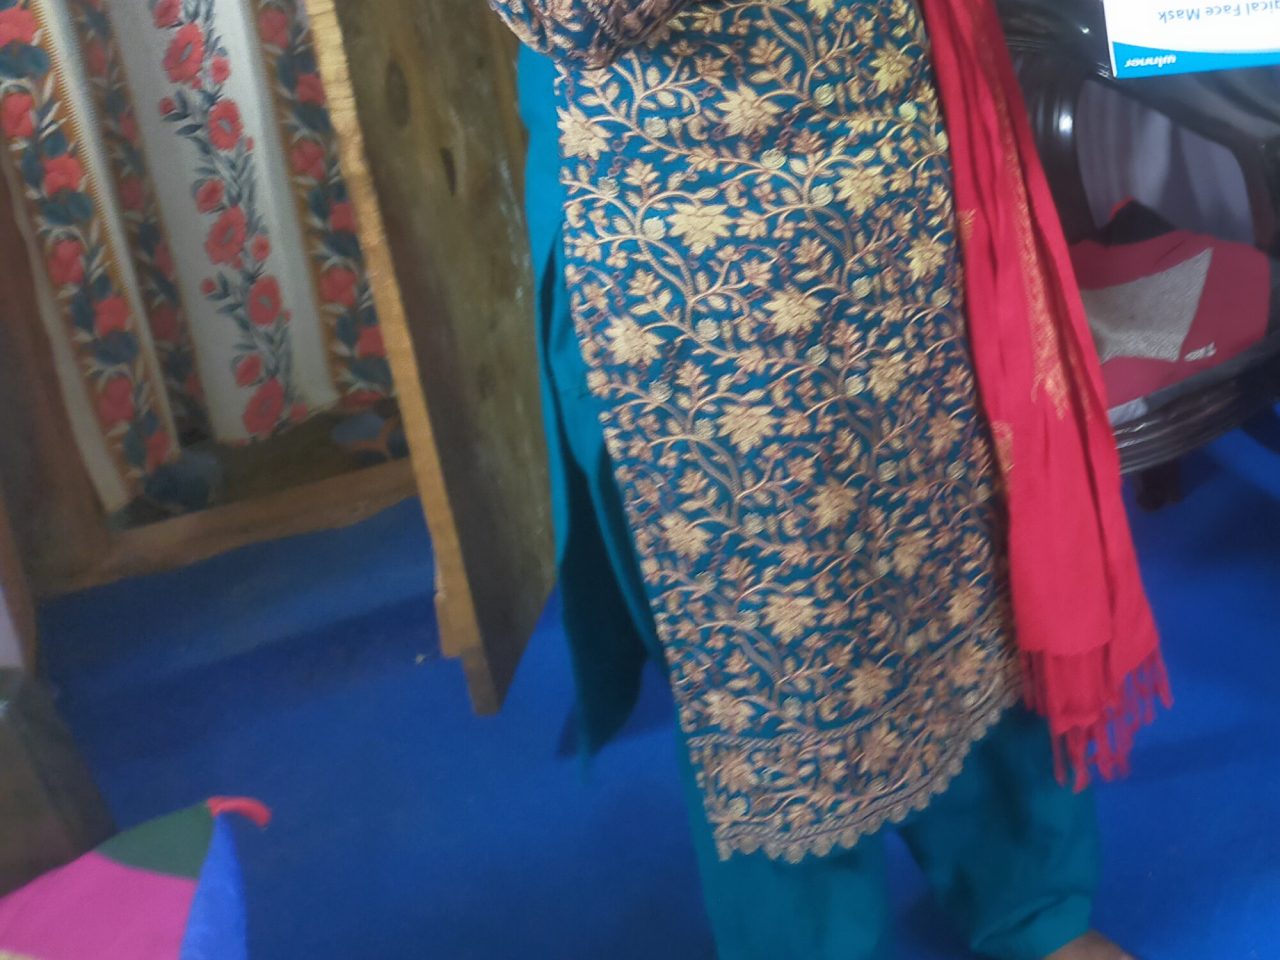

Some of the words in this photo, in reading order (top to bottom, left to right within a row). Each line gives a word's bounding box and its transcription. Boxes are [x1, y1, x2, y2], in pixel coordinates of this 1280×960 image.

[1158, 7, 1200, 24] Mask
[1205, 2, 1242, 17] Face
[1124, 54, 1177, 68] winner
